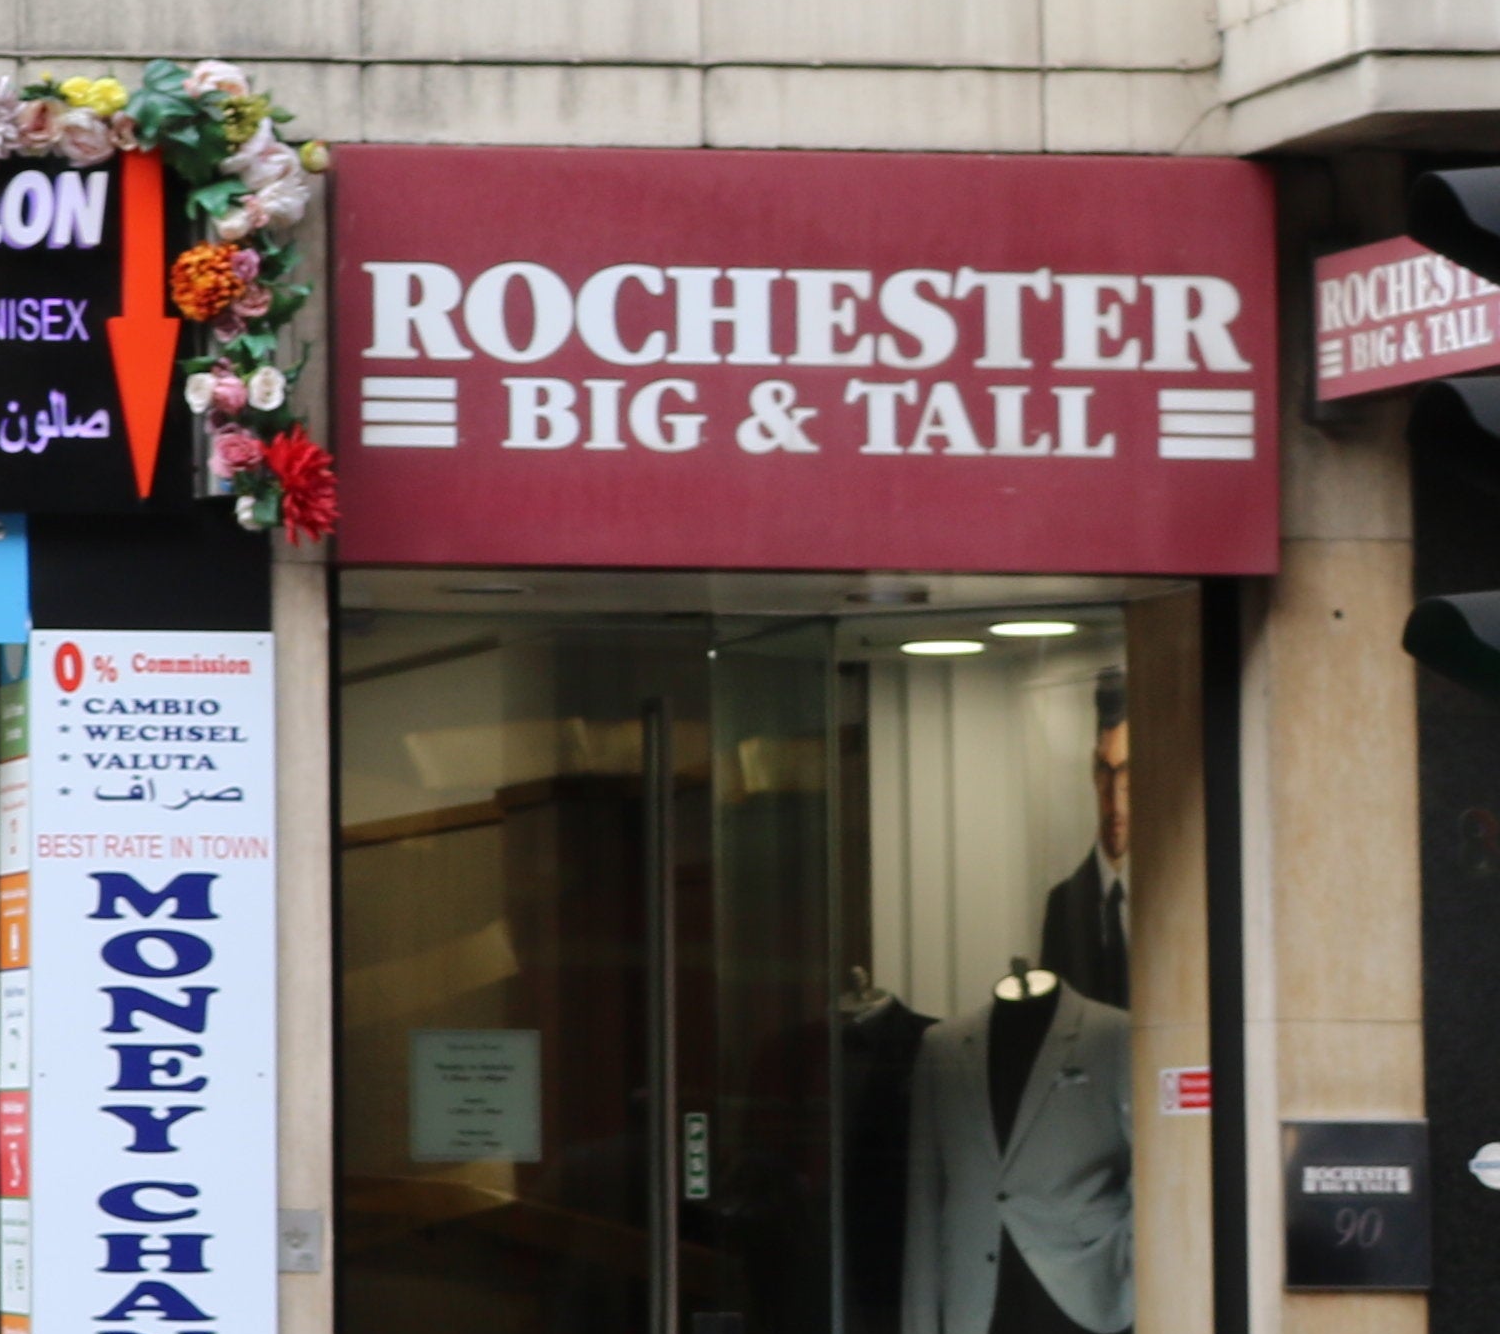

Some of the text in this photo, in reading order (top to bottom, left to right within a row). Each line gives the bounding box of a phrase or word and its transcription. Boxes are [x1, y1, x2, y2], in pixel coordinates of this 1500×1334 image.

[361, 261, 1254, 373] ROCHESTER
[1351, 303, 1494, 372] BIG & TALL
[501, 378, 1116, 459] BIG & TALL
[132, 652, 252, 676] Commission
[83, 697, 221, 716] CAMBIO
[83, 724, 249, 743] WECHSEL
[83, 752, 218, 771] VALUTA
[38, 835, 269, 860] BEST RATE IN TOWN
[85, 871, 222, 1154] MONEY
[1334, 1207, 1384, 1248] 90
